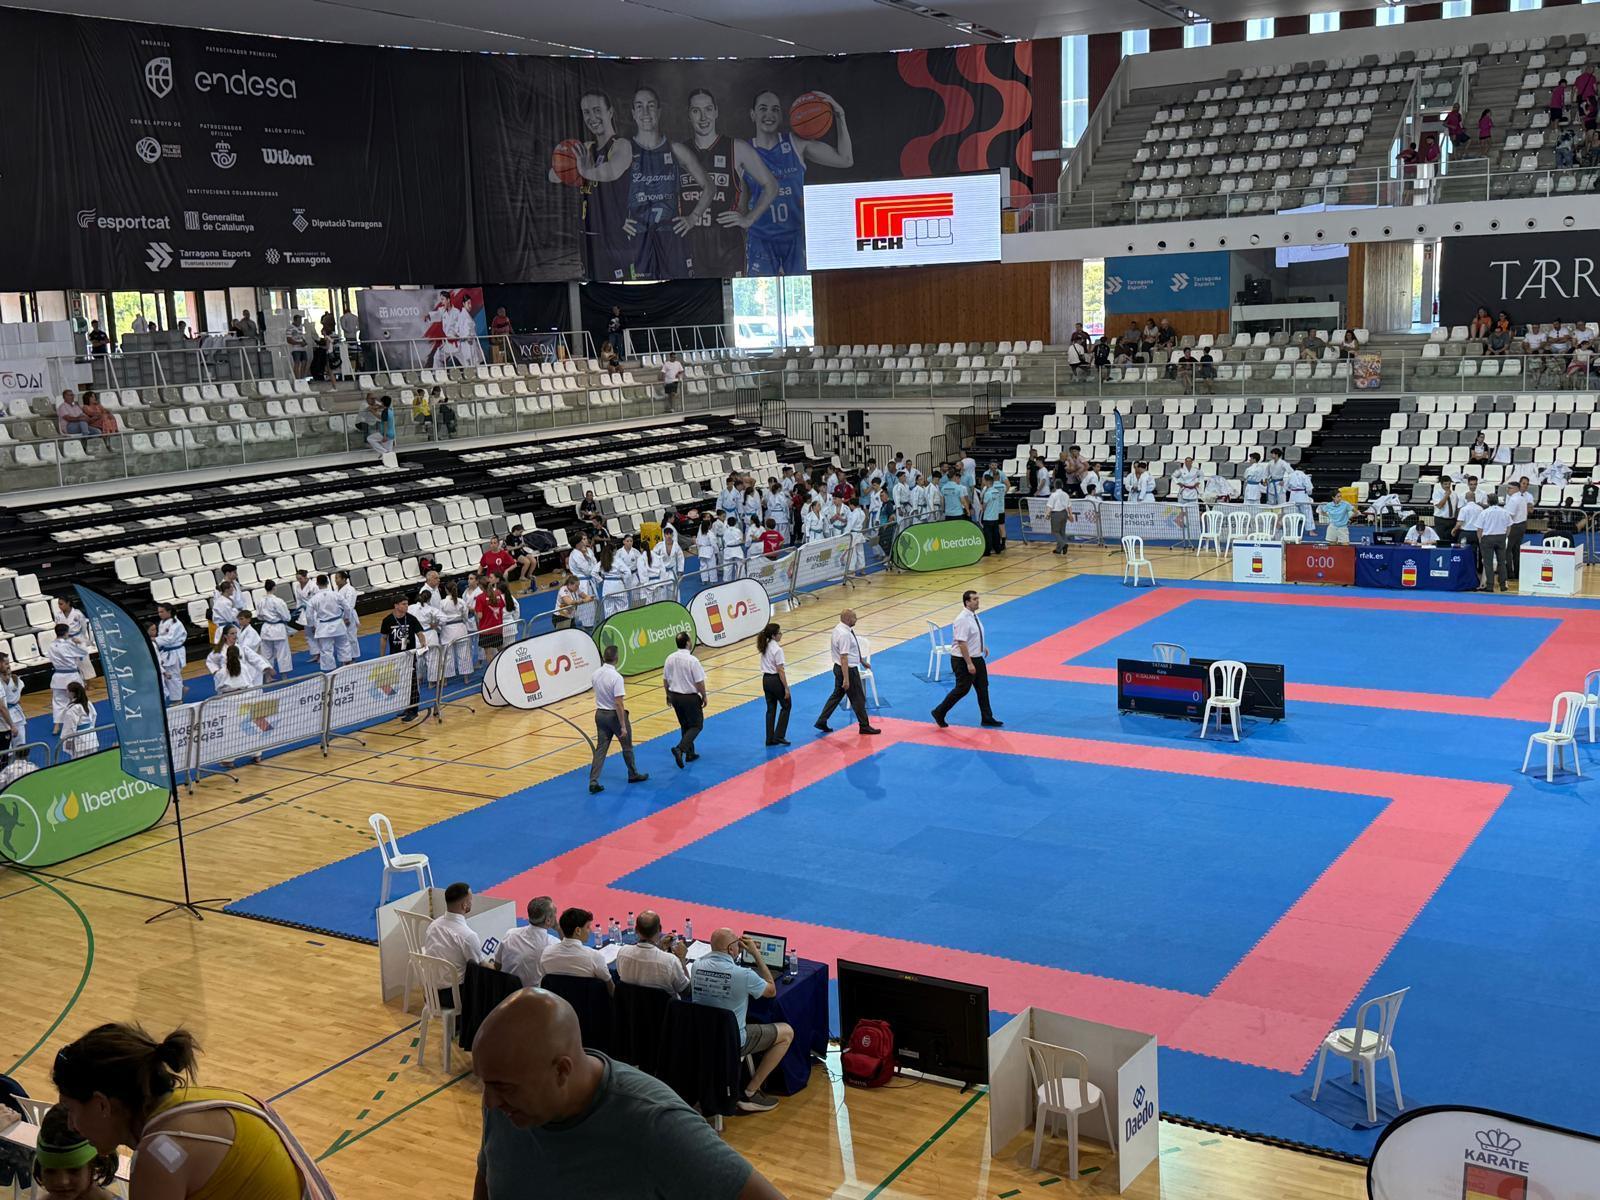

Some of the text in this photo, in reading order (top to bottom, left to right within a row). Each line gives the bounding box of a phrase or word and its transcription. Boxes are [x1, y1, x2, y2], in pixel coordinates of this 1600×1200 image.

[205, 46, 277, 58] PATROCINADOR PRINCIPAL
[195, 69, 297, 99] endesa
[200, 123, 242, 131] PATROCINADOR
[261, 148, 314, 166] Wilson
[186, 188, 230, 196] INSTITUCIONES
[202, 212, 245, 222] Generalitat
[651, 207, 664, 223] 7
[770, 203, 788, 223] 10
[97, 215, 171, 232] esportcat
[203, 223, 255, 233] de Catalunya
[312, 219, 382, 230] Diputació Tarragona
[180, 250, 251, 258] Tarragona Esports
[389, 306, 420, 318] MOOTO
[940, 535, 982, 550] Iberdrola
[1359, 551, 1384, 560] rfek.es
[1306, 555, 1335, 569] 0:00
[1436, 556, 1443, 568] 1
[647, 621, 692, 643] Iberdrola
[1193, 691, 1199, 701] 0
[1125, 1100, 1154, 1143] Daedo
[1464, 1148, 1530, 1174] KARATE
